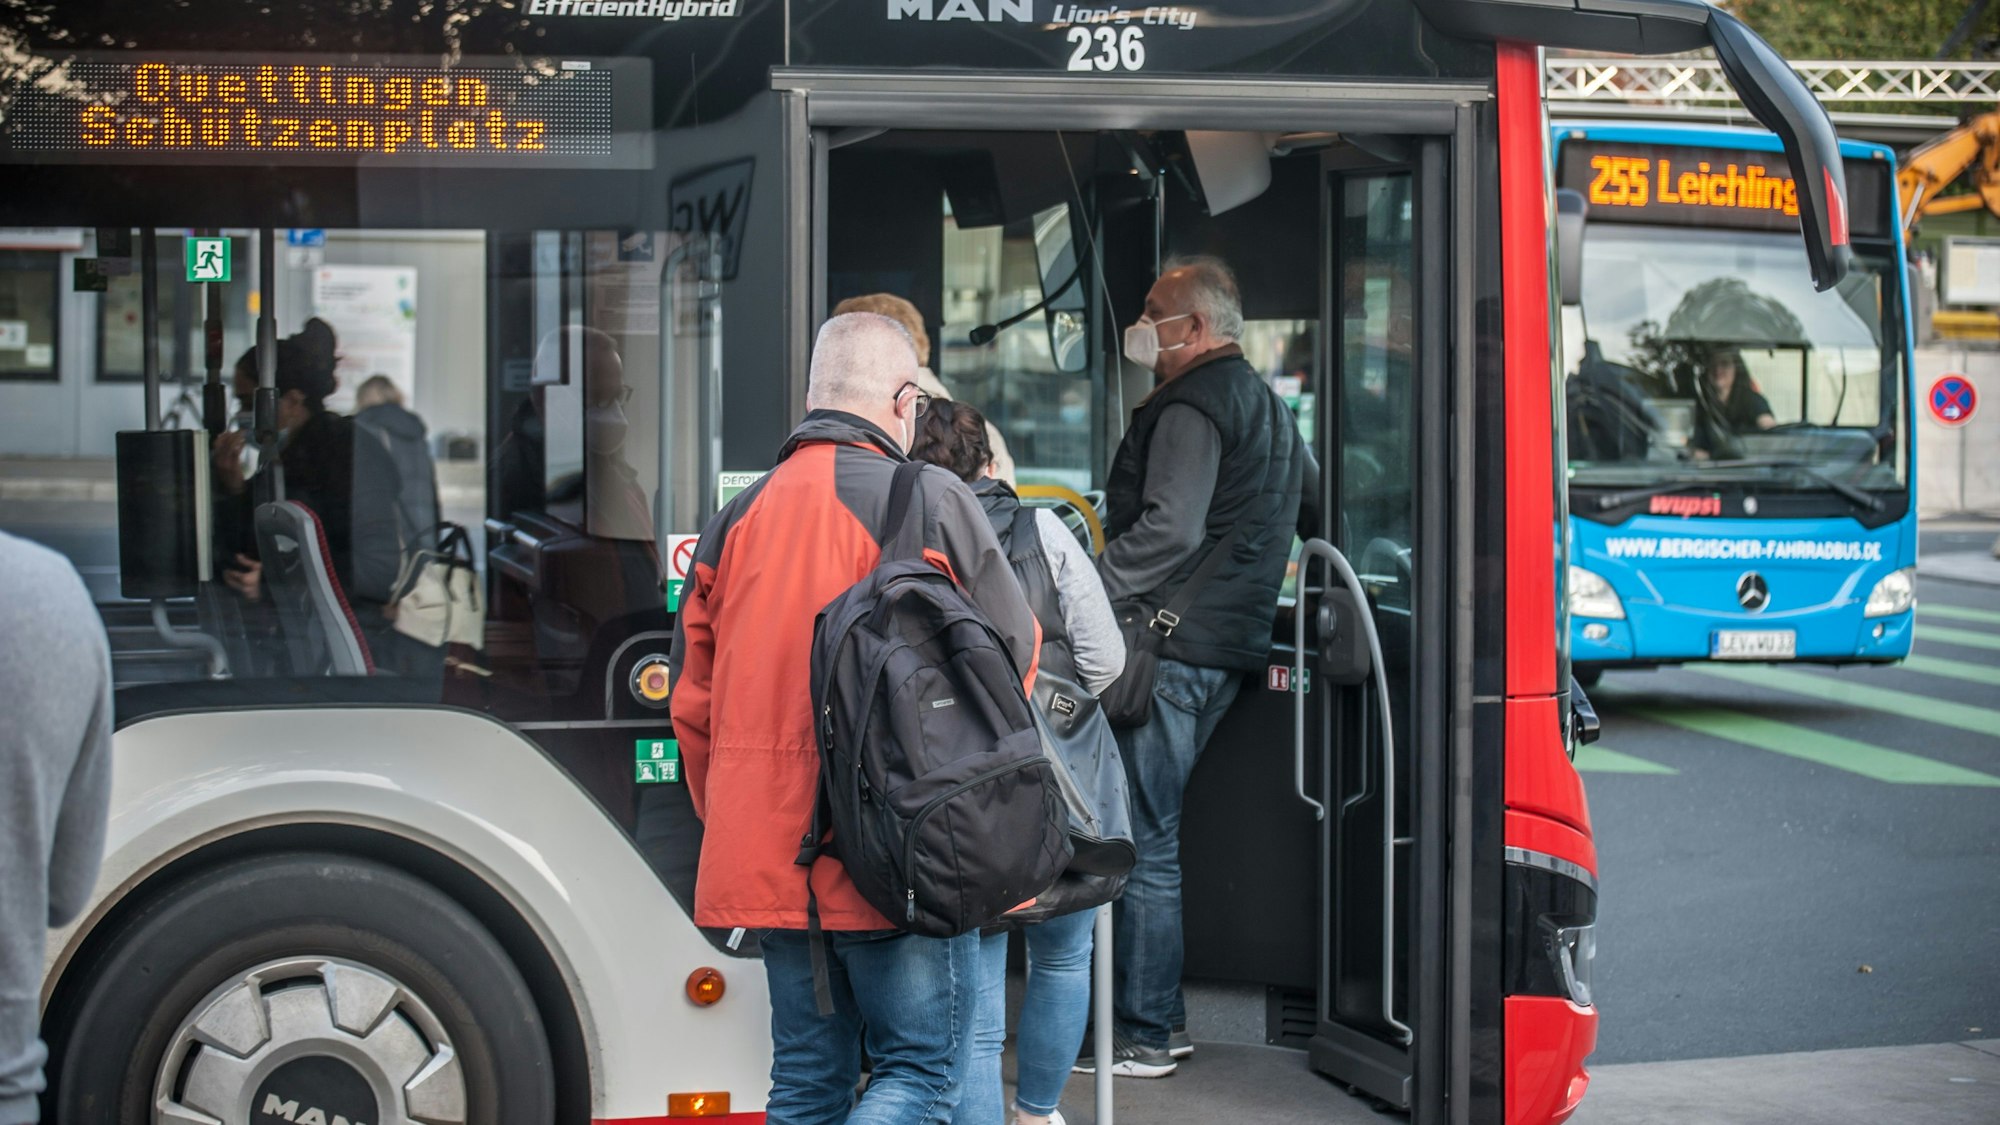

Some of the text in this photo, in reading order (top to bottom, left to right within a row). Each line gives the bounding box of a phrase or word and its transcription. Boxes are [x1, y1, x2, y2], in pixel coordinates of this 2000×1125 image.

[528, 0, 735, 21] EfficientHybrid
[887, 0, 1033, 23] MAN
[1052, 4, 1198, 30] Lion's City
[1066, 25, 1145, 72] 236
[136, 63, 487, 111] Quettingen
[82, 105, 545, 154] Schützenplatz
[1589, 155, 1650, 207] 255
[1650, 492, 1721, 520] wupsi
[1606, 537, 1882, 562] WWW.BERGISCHER-FAHRRADBUS.DE
